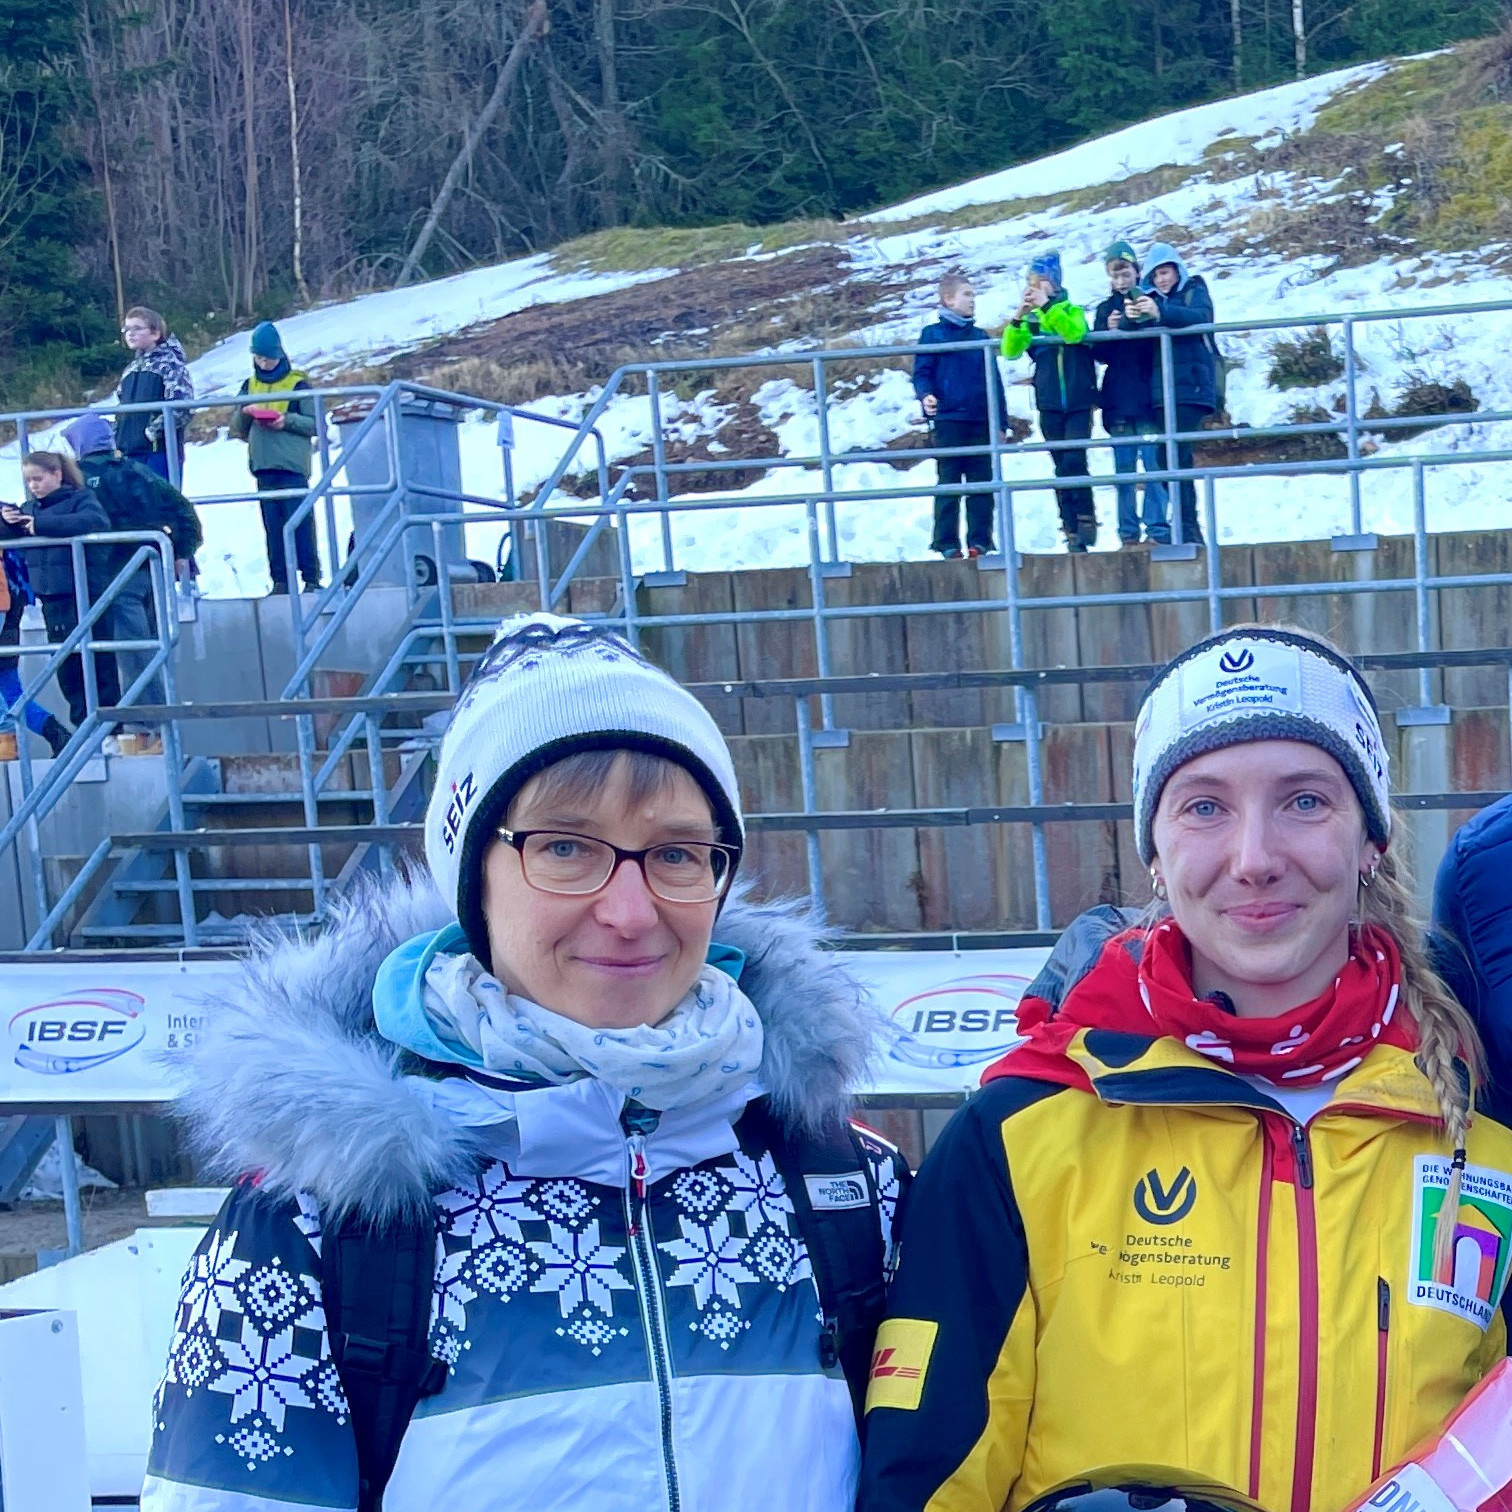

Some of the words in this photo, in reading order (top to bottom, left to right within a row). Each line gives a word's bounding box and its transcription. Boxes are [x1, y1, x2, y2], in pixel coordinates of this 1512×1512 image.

[1216, 675, 1260, 689] Deutsche
[1236, 694, 1273, 704] Leopold
[912, 1009, 1018, 1033] IBSF
[27, 1021, 127, 1042] IBSF
[1422, 1164, 1440, 1173] DIE
[819, 1187, 849, 1195] NORTH
[1126, 1234, 1193, 1248] Deutsche
[1151, 1273, 1206, 1288] Leopold
